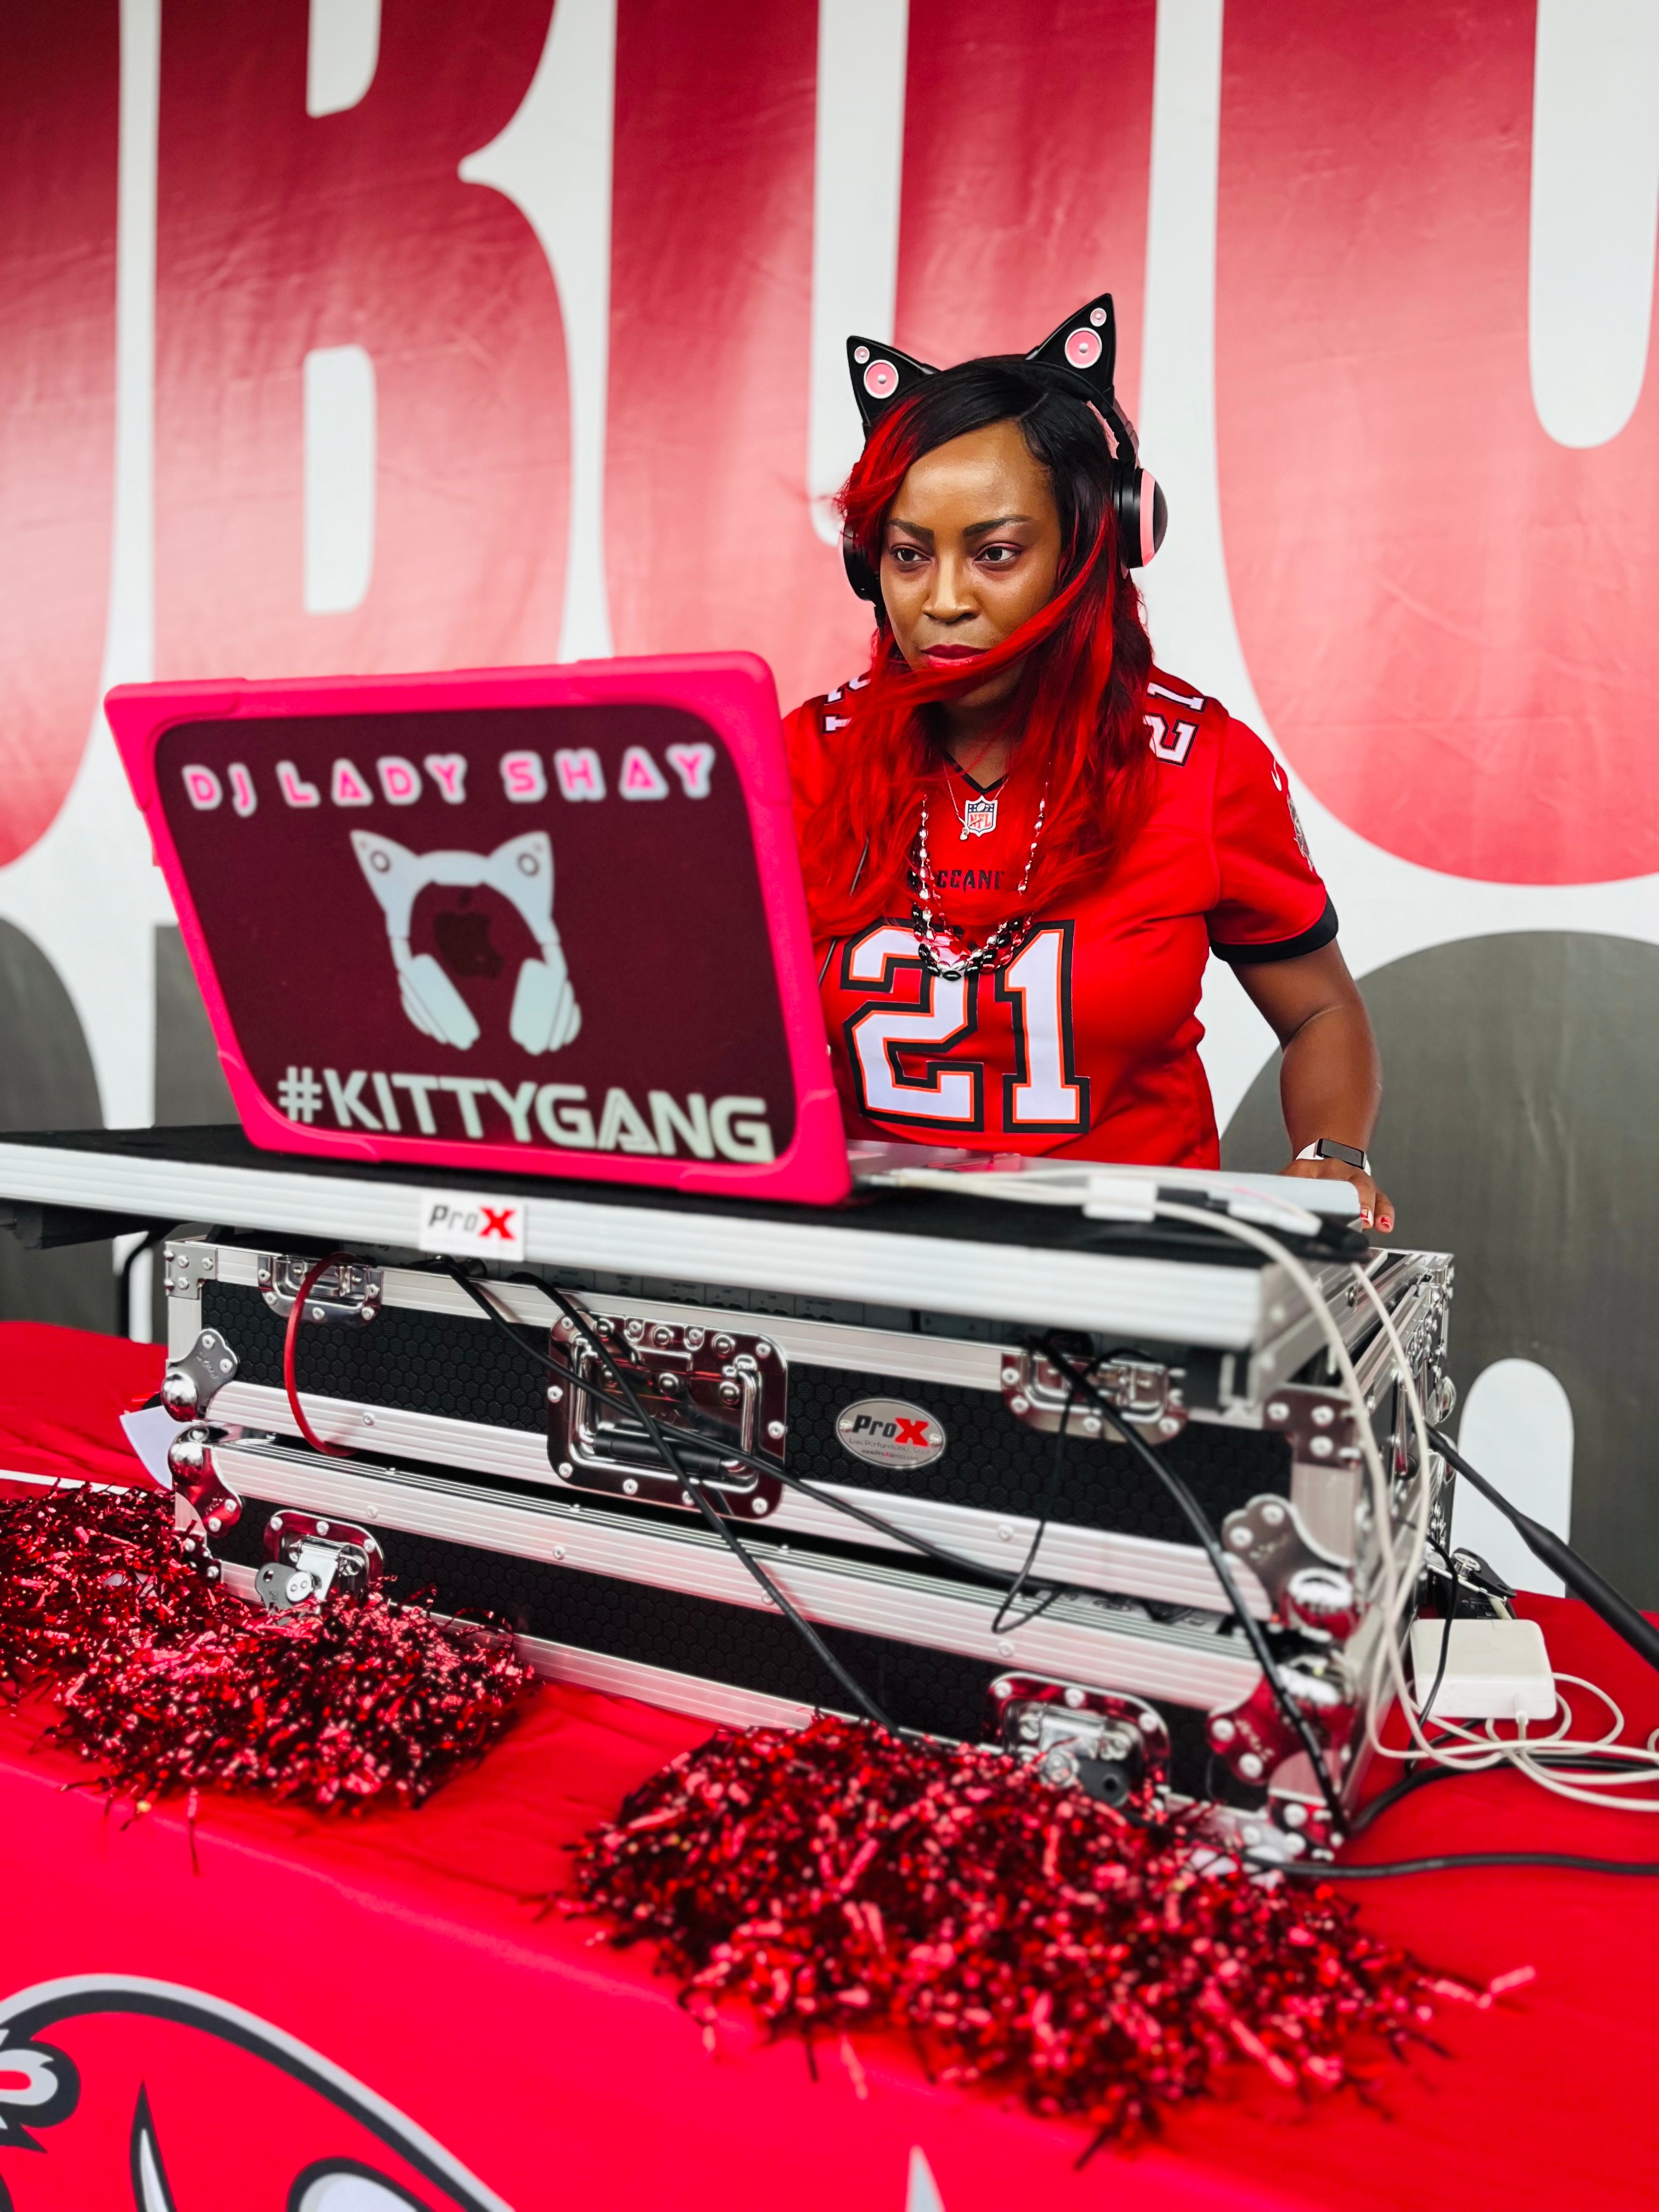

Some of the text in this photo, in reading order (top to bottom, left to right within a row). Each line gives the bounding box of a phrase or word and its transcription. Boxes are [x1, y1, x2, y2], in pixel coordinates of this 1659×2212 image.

[183, 743, 715, 817] DJ LADY SHAY
[969, 814, 991, 828] NFL
[840, 919, 1090, 1133] 21
[278, 1066, 775, 1164] #KITTYGANG
[428, 1205, 516, 1240] ProX
[852, 1414, 929, 1446] ProX
